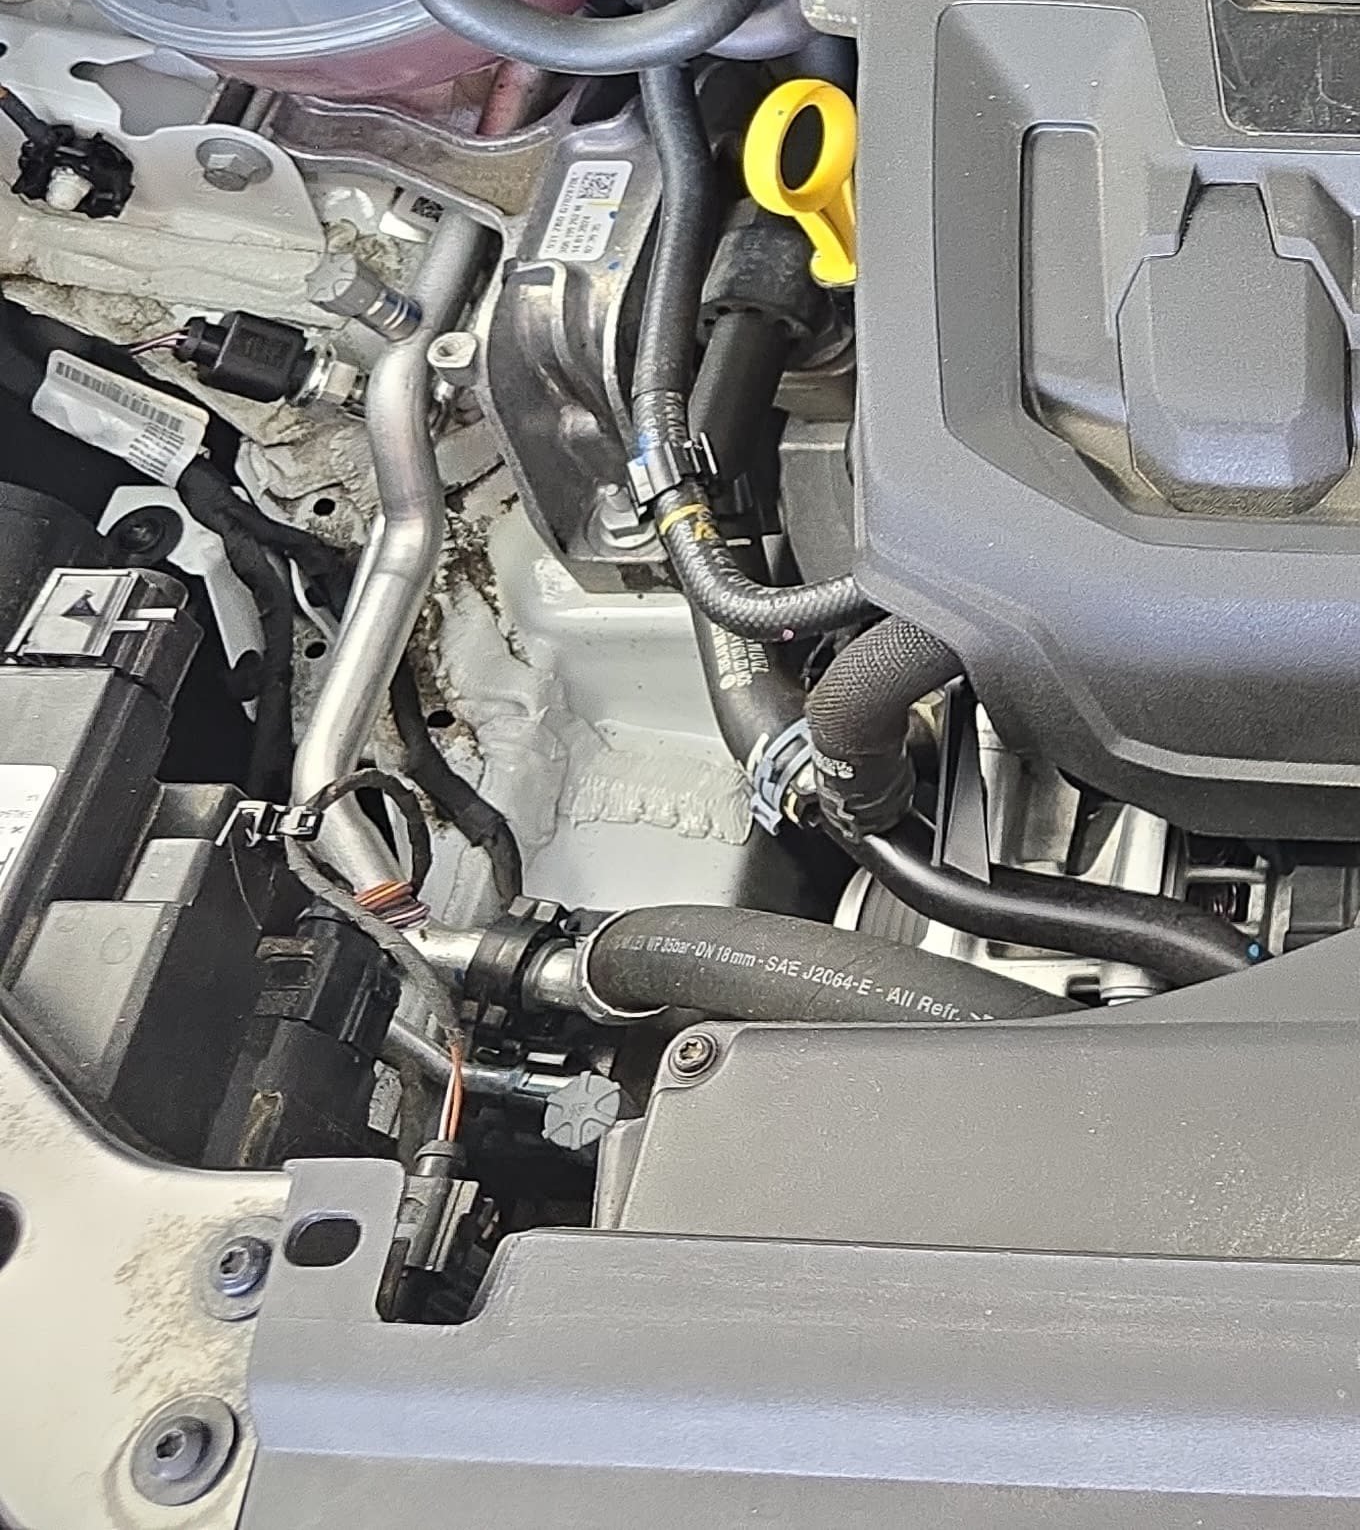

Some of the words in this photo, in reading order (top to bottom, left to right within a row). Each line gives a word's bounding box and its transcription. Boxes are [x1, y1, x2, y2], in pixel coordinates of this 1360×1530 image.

[717, 945, 756, 967] 18mm
[765, 956, 801, 977] SAE
[802, 964, 873, 995] J2064-E
[886, 986, 915, 1008] All
[917, 996, 960, 1021] Refr.
